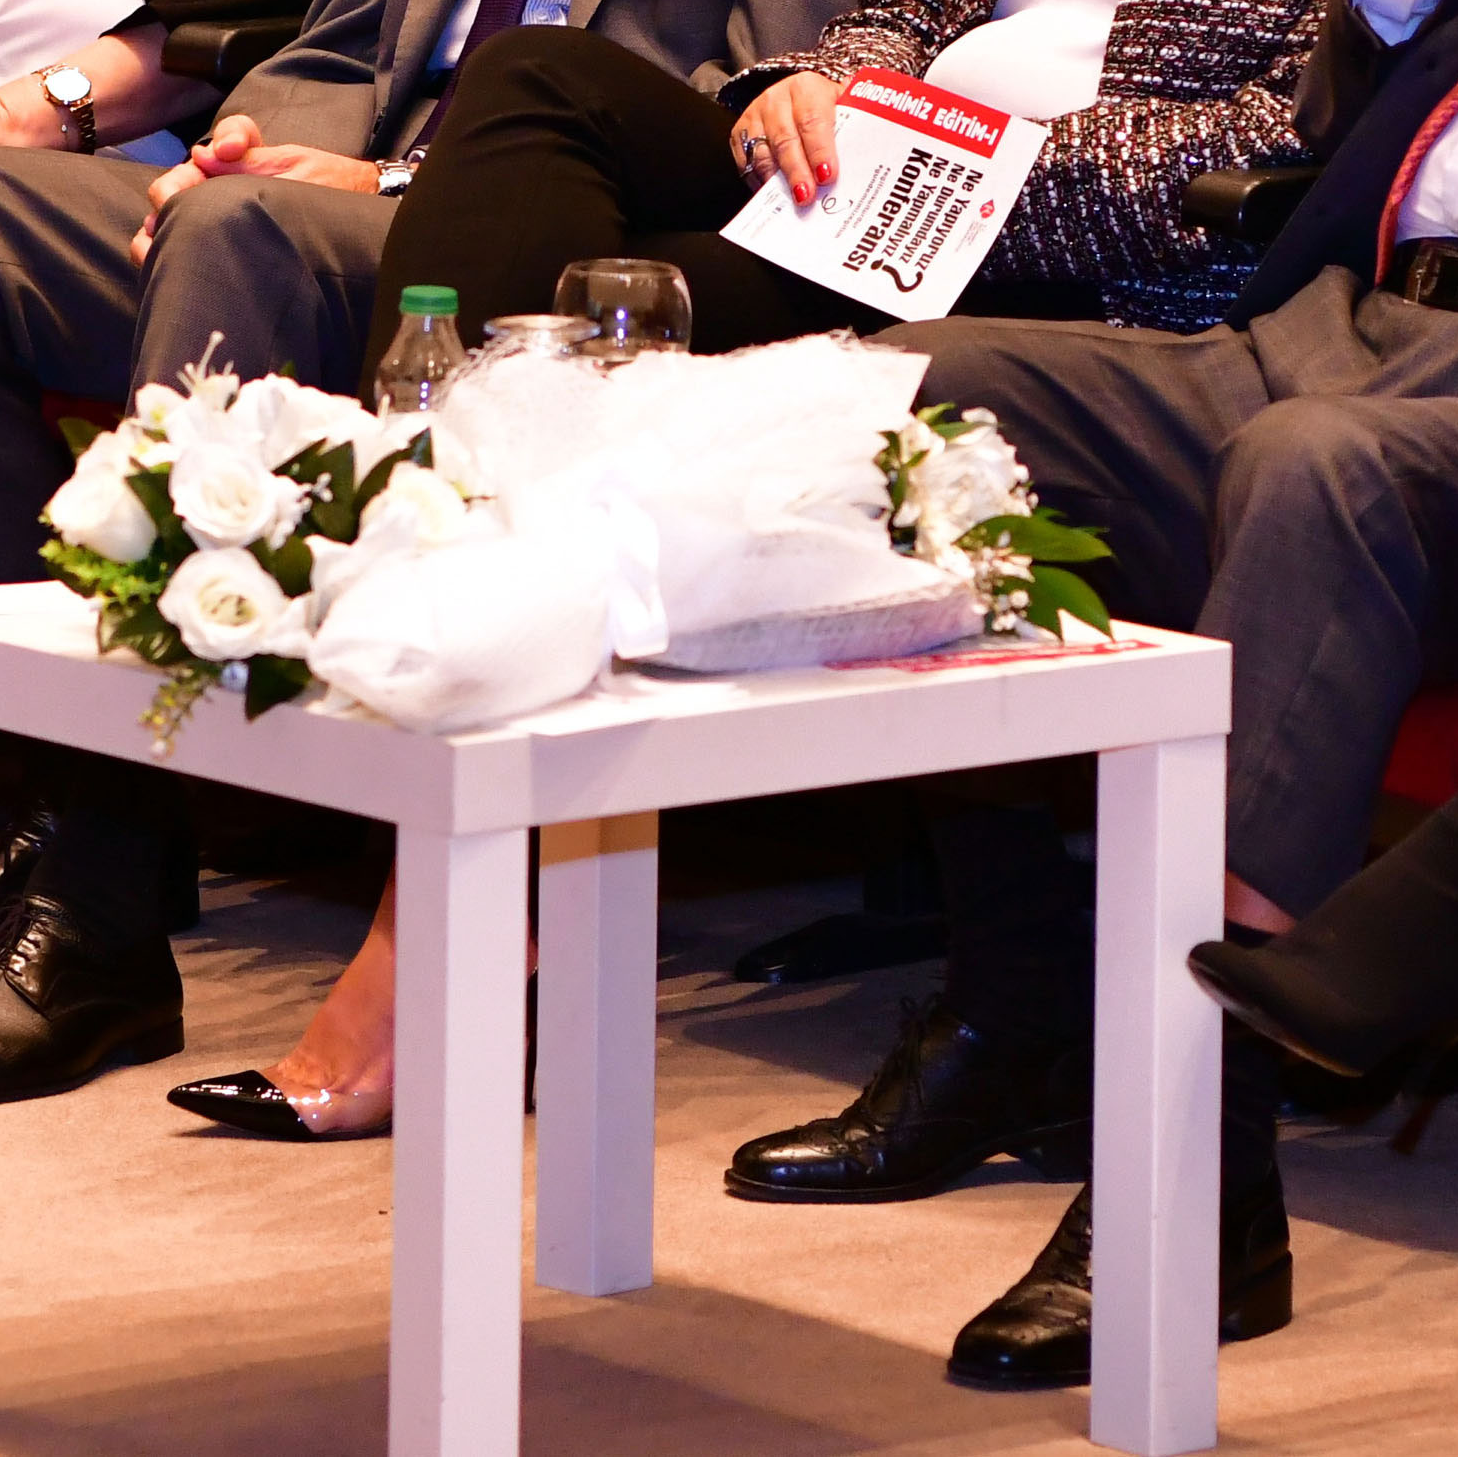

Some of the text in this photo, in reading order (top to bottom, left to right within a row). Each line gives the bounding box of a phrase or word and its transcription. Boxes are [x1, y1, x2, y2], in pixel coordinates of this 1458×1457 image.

[849, 79, 933, 121] GÜNDEMİMİZ
[842, 147, 933, 272] Konferansı
[881, 156, 950, 258] Ne Yapmalıyız
[946, 163, 966, 183] Ne
[962, 169, 984, 192] Ne
[898, 185, 954, 264] Durumdayız
[915, 198, 971, 271] Yapıyoruz
